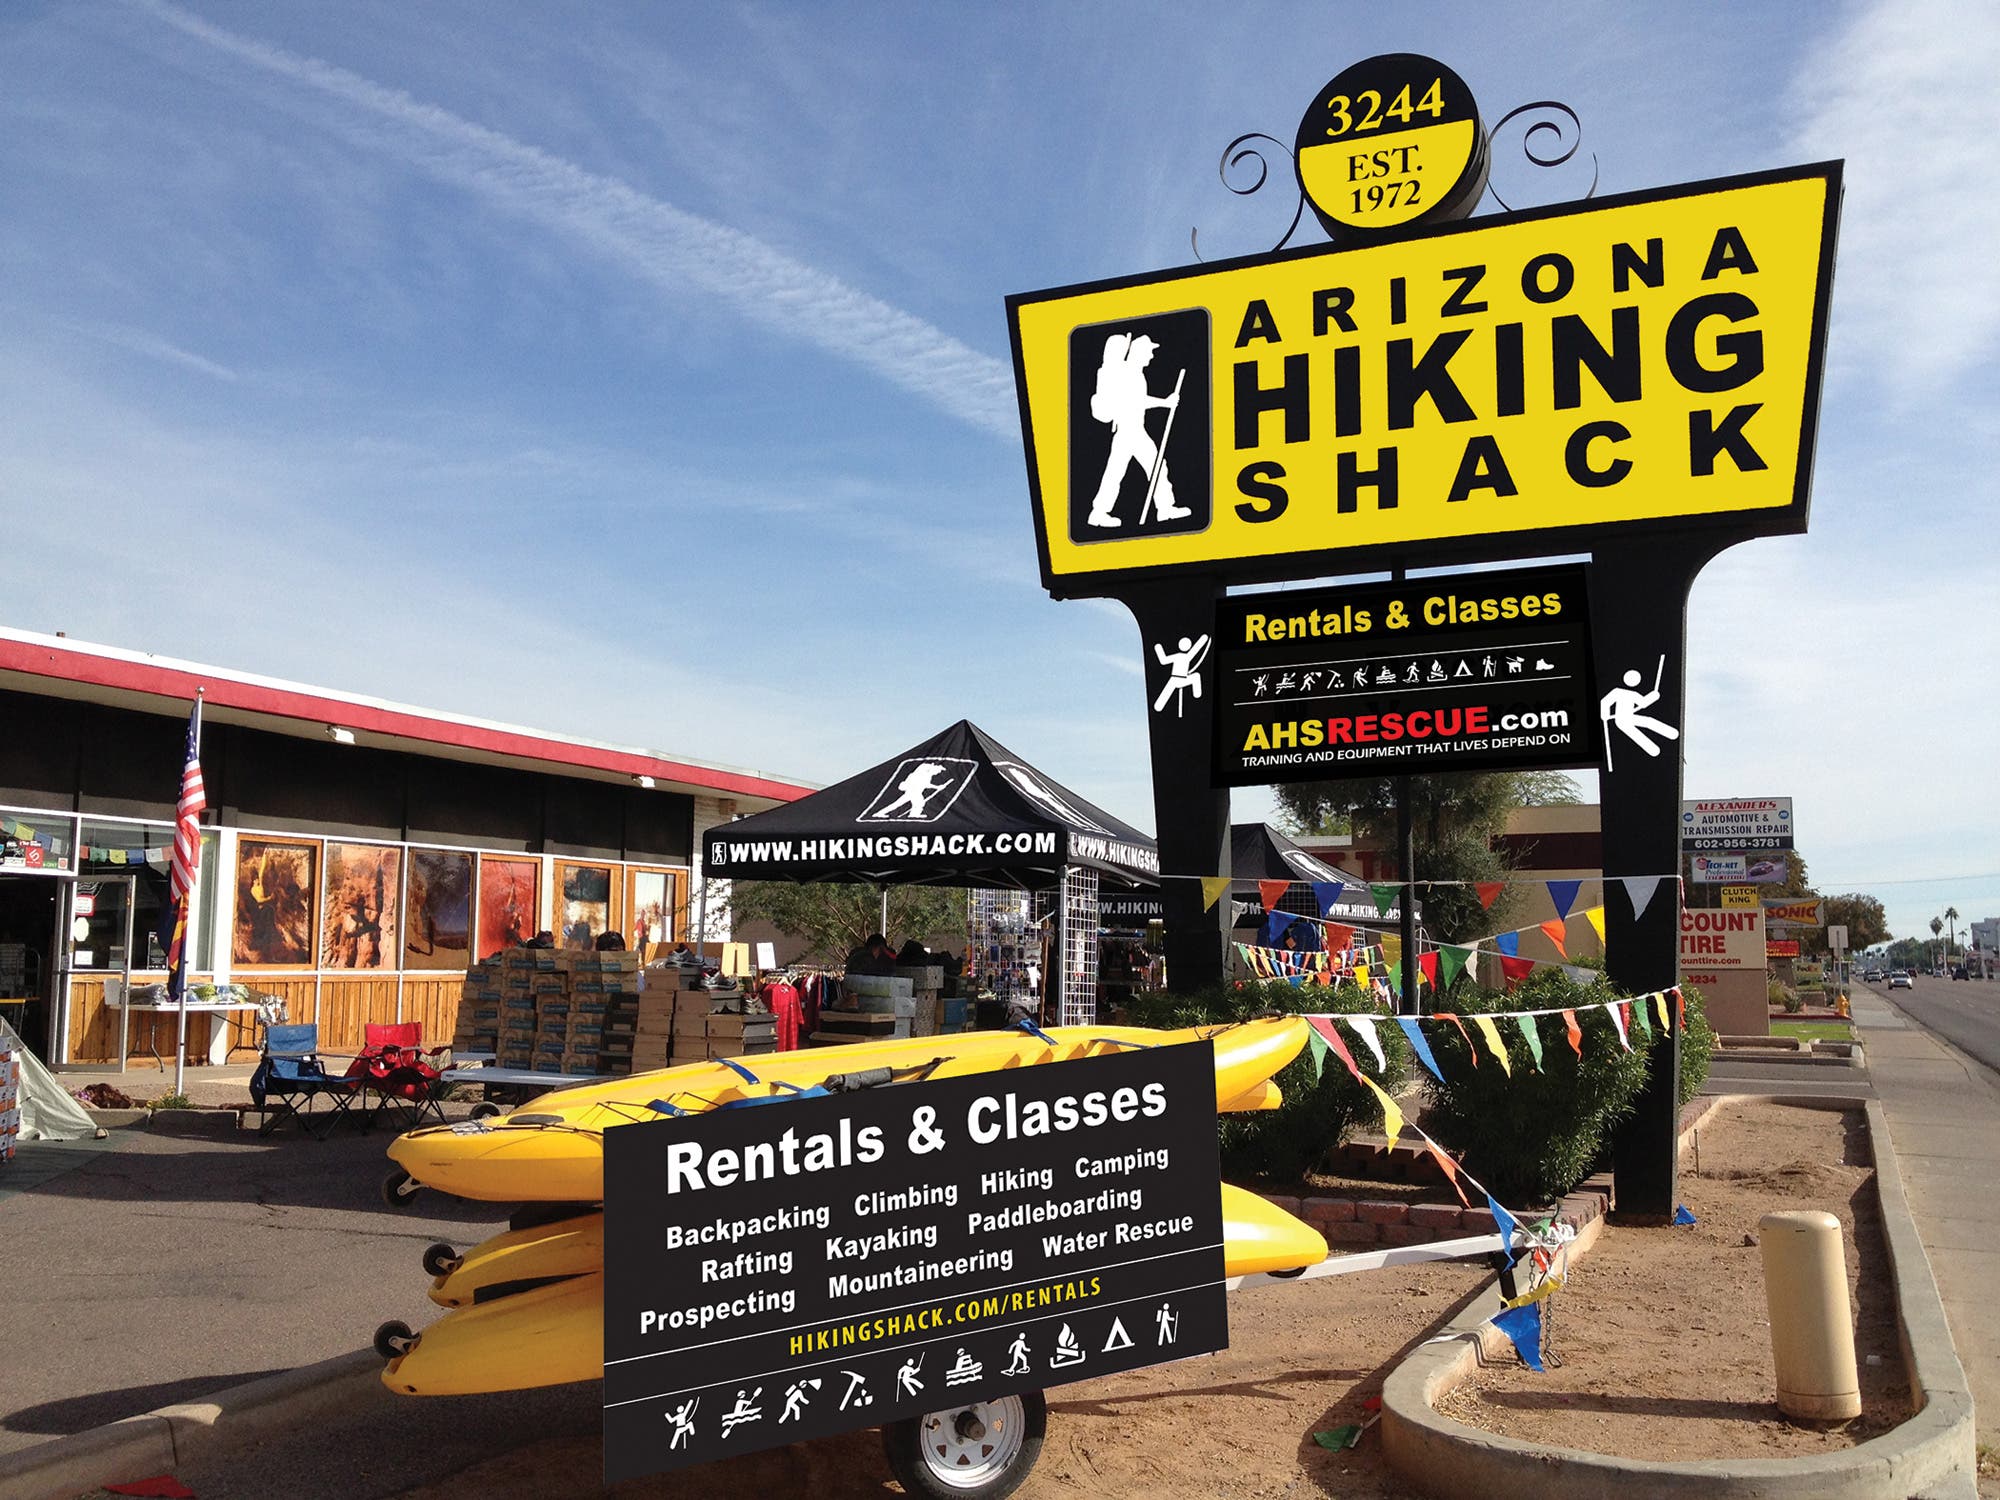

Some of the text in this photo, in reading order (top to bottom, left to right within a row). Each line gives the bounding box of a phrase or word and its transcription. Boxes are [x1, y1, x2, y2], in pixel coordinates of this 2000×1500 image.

[1326, 77, 1445, 136] 3244
[1347, 143, 1424, 182] EST.
[1349, 178, 1422, 215] 1972
[1234, 226, 1759, 348] ARIZONA
[1234, 292, 1765, 450] HIKING
[1235, 403, 1768, 523] SHACK
[1245, 592, 1562, 643] Rentals & Classes
[1242, 706, 1569, 752] AHSRESCUE.com
[1242, 733, 1571, 767] TRAINING AND EQUIPMENT THAT LIVES DEPEND ON
[1695, 800, 1777, 811] ALEXANDER'S
[1702, 813, 1759, 824] AUTOMOTIVE
[1762, 813, 1769, 822] &
[730, 832, 1057, 864] WWW.HIKINGSHACK.COM
[1683, 824, 1789, 835] TRANSMISSION REPAIR
[1694, 838, 1780, 848] 602-956-3781
[1765, 906, 1815, 918] SONIC
[1680, 935, 1726, 954] TIRE
[666, 1081, 1168, 1194] Rentals & Classes
[666, 1146, 1169, 1251] Backpacking Climbing Hiking Camping
[702, 1186, 1142, 1284] Rafting Kayaking Paddleboarding
[640, 1215, 1194, 1335] Prospecting Mountaineering Water Rescue
[790, 1276, 1102, 1357] HIKINGSHACK.COM/RENTALS
